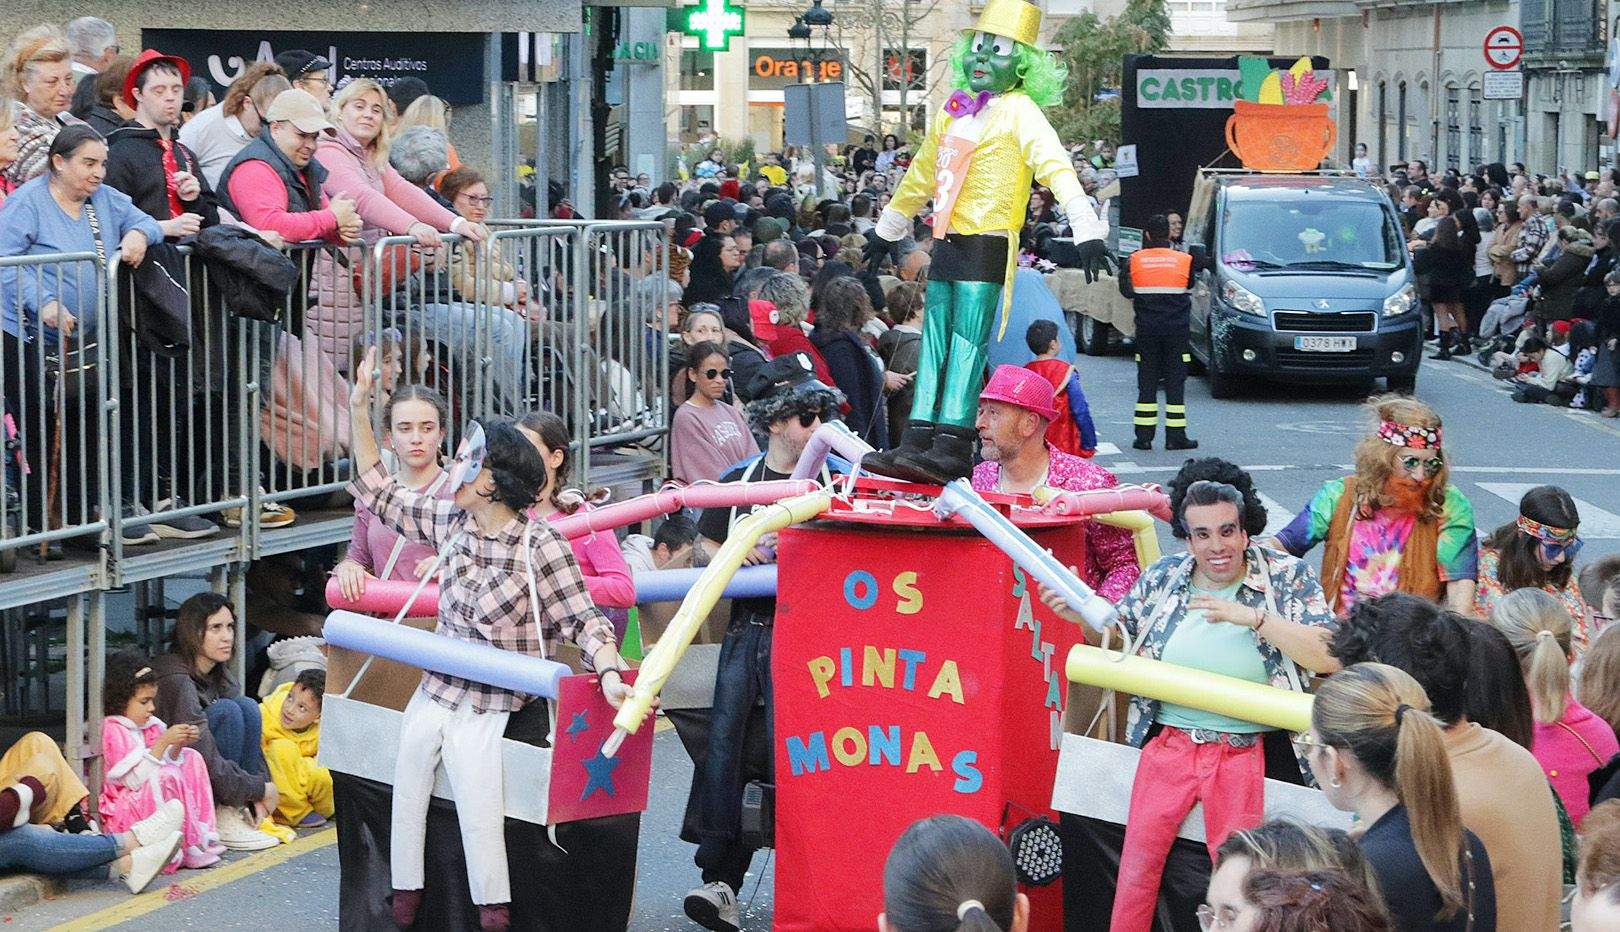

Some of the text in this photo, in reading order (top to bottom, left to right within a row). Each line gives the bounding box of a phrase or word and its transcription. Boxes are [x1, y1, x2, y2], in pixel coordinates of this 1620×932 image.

[343, 56, 428, 71] Centros Auditivos
[843, 569, 924, 615] OS
[806, 645, 965, 705] PINTA
[785, 725, 984, 794] MONAS
